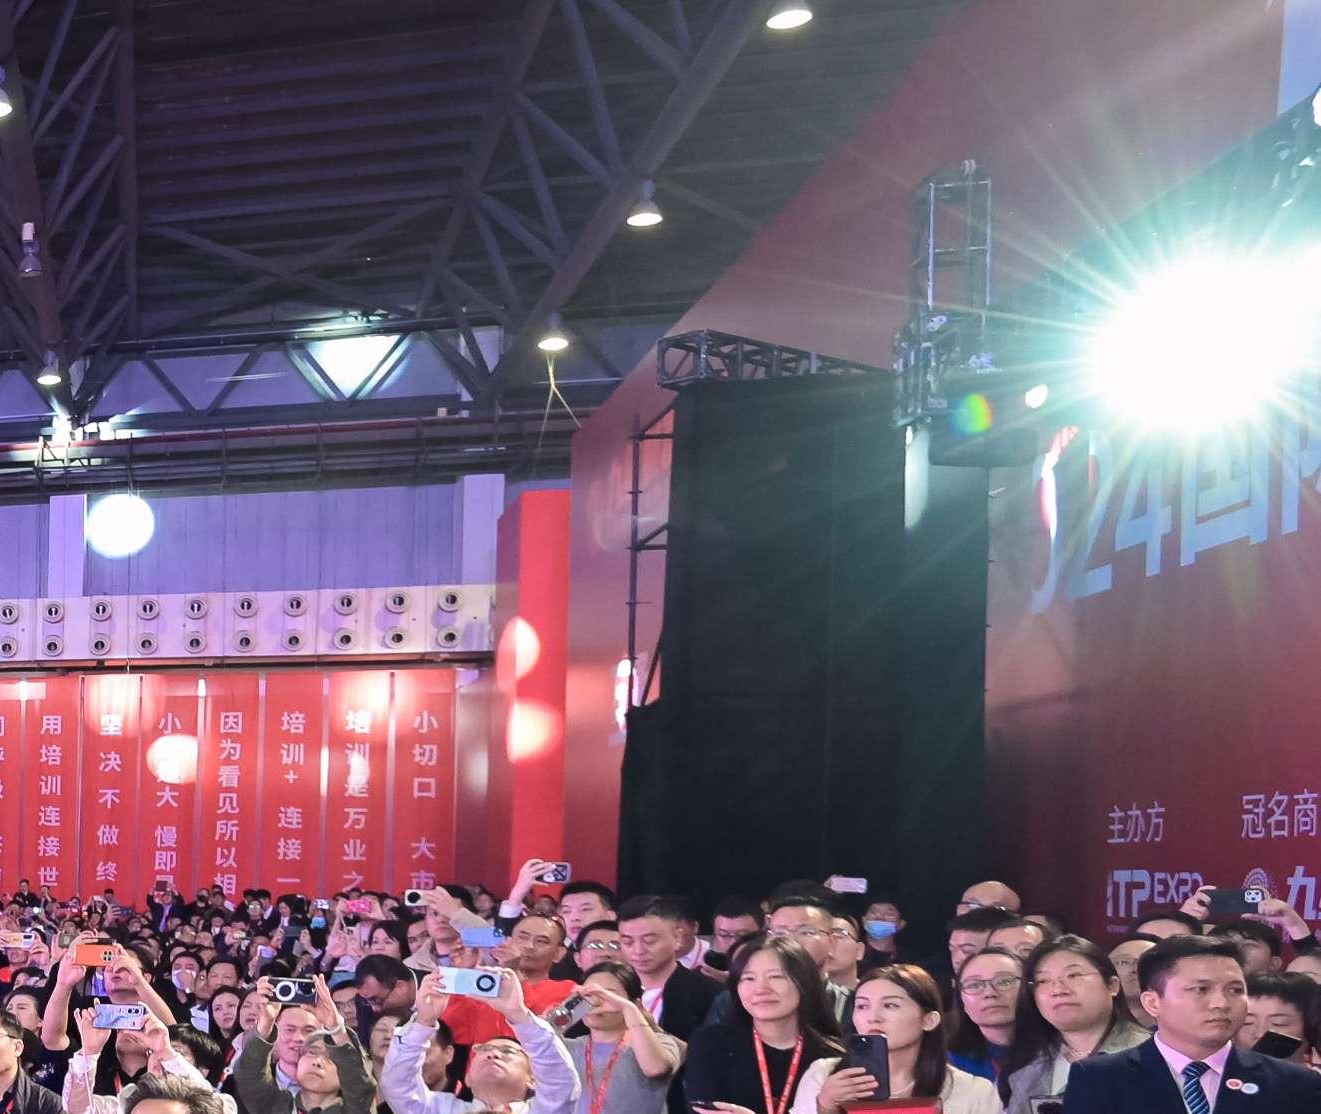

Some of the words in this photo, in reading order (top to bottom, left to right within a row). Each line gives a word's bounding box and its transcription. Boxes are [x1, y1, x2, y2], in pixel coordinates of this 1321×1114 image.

[411, 710, 439, 799] 小切口
[1107, 800, 1167, 844] 主办方
[1240, 787, 1319, 839] 冠名商
